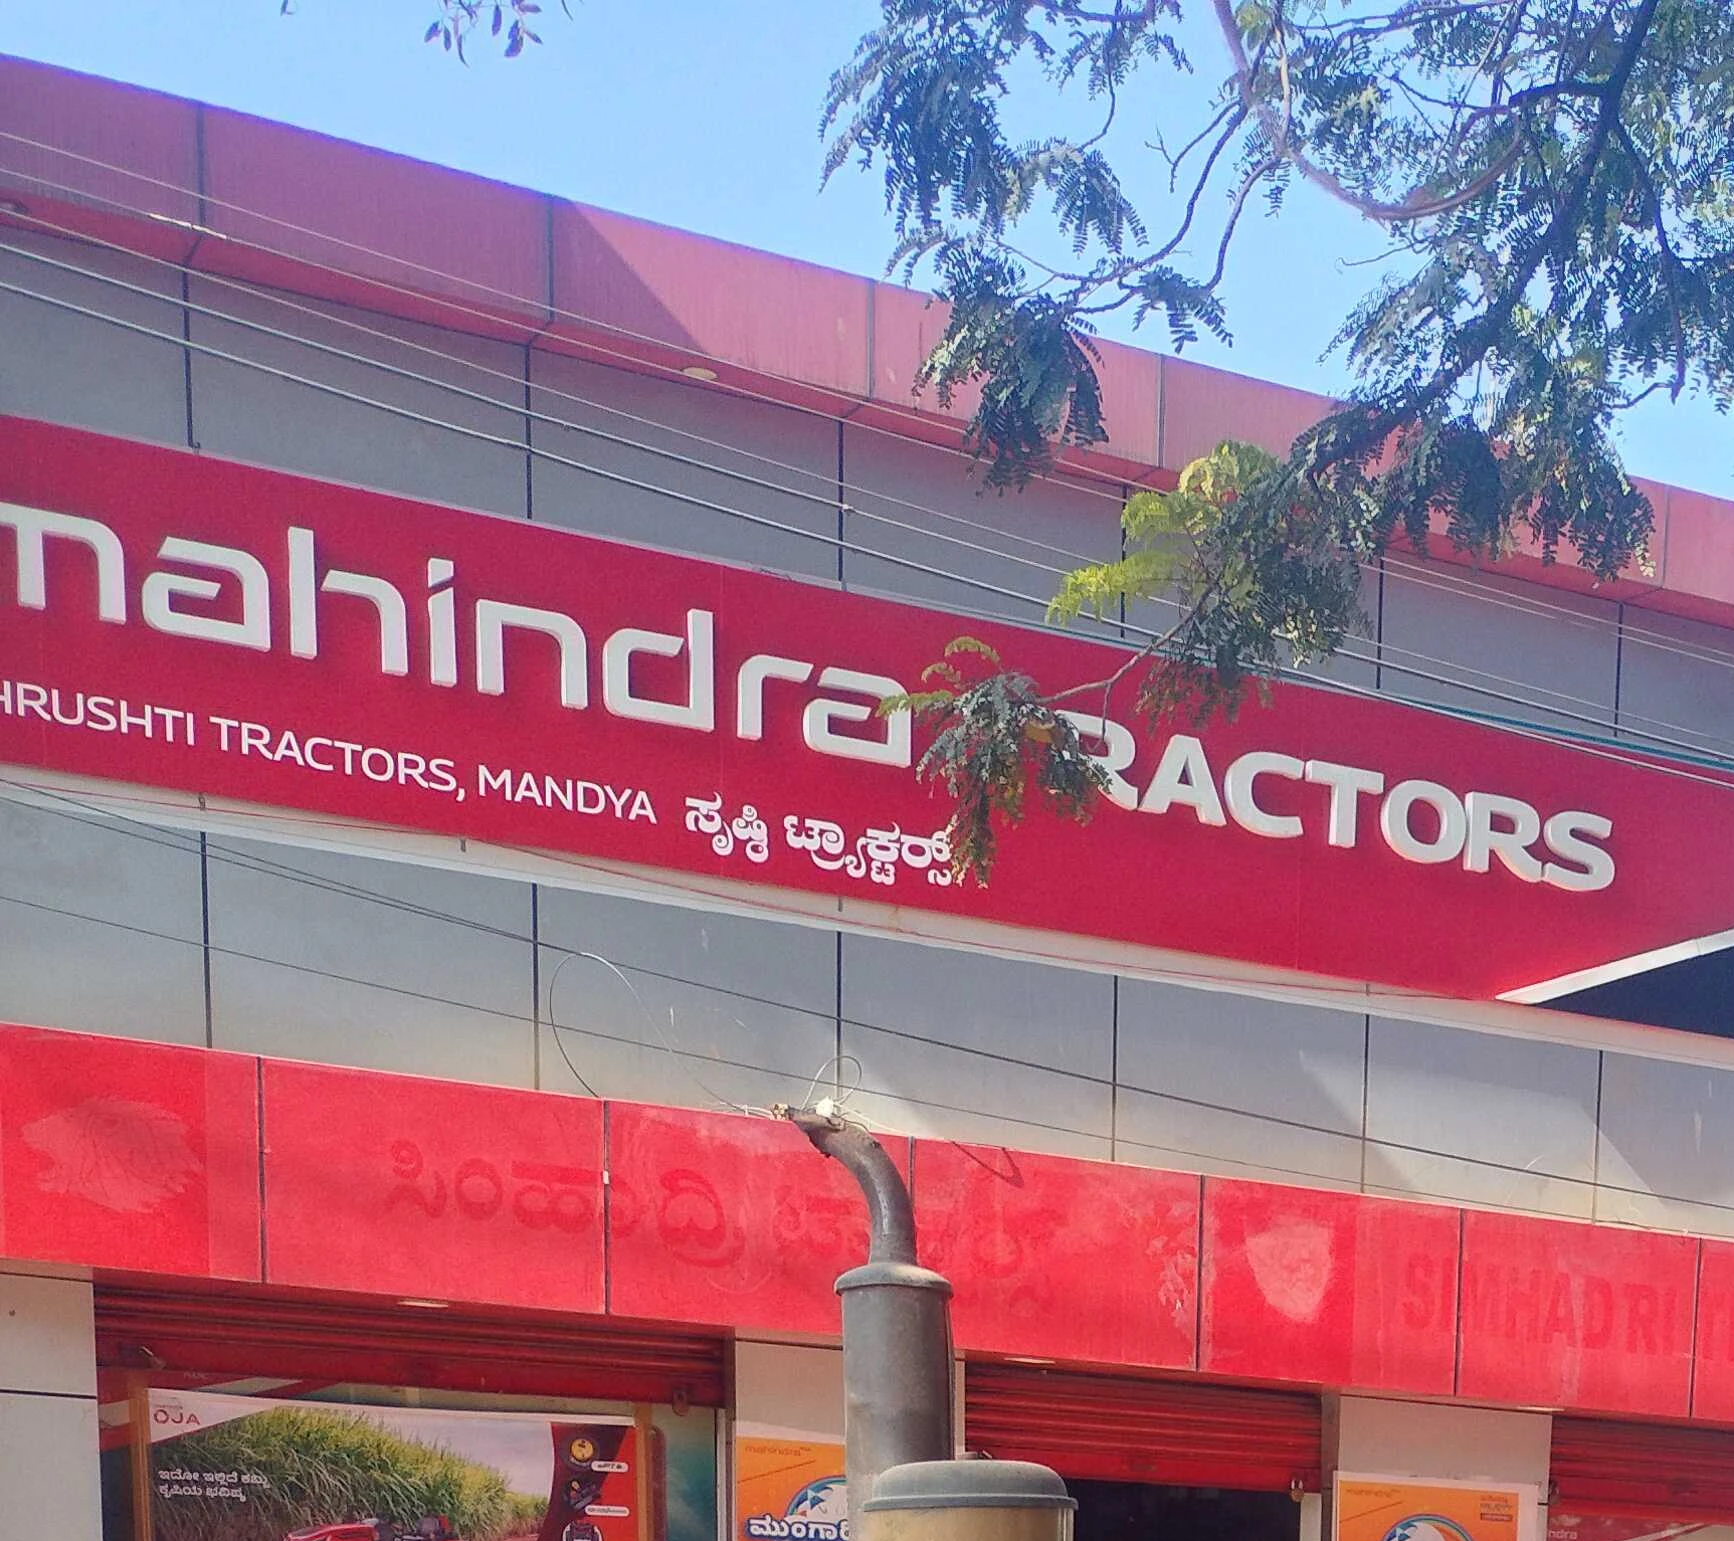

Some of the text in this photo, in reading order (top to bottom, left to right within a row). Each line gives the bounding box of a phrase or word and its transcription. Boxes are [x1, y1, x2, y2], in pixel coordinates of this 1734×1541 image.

[0, 502, 912, 767] mahindra
[209, 715, 466, 803] TRACTORS,
[478, 763, 657, 824] MANDYA
[1048, 711, 1616, 892] RACTORS
[153, 1408, 201, 1426] OJA
[748, 1513, 850, 1539] ಮುಂಗಾರಿ
